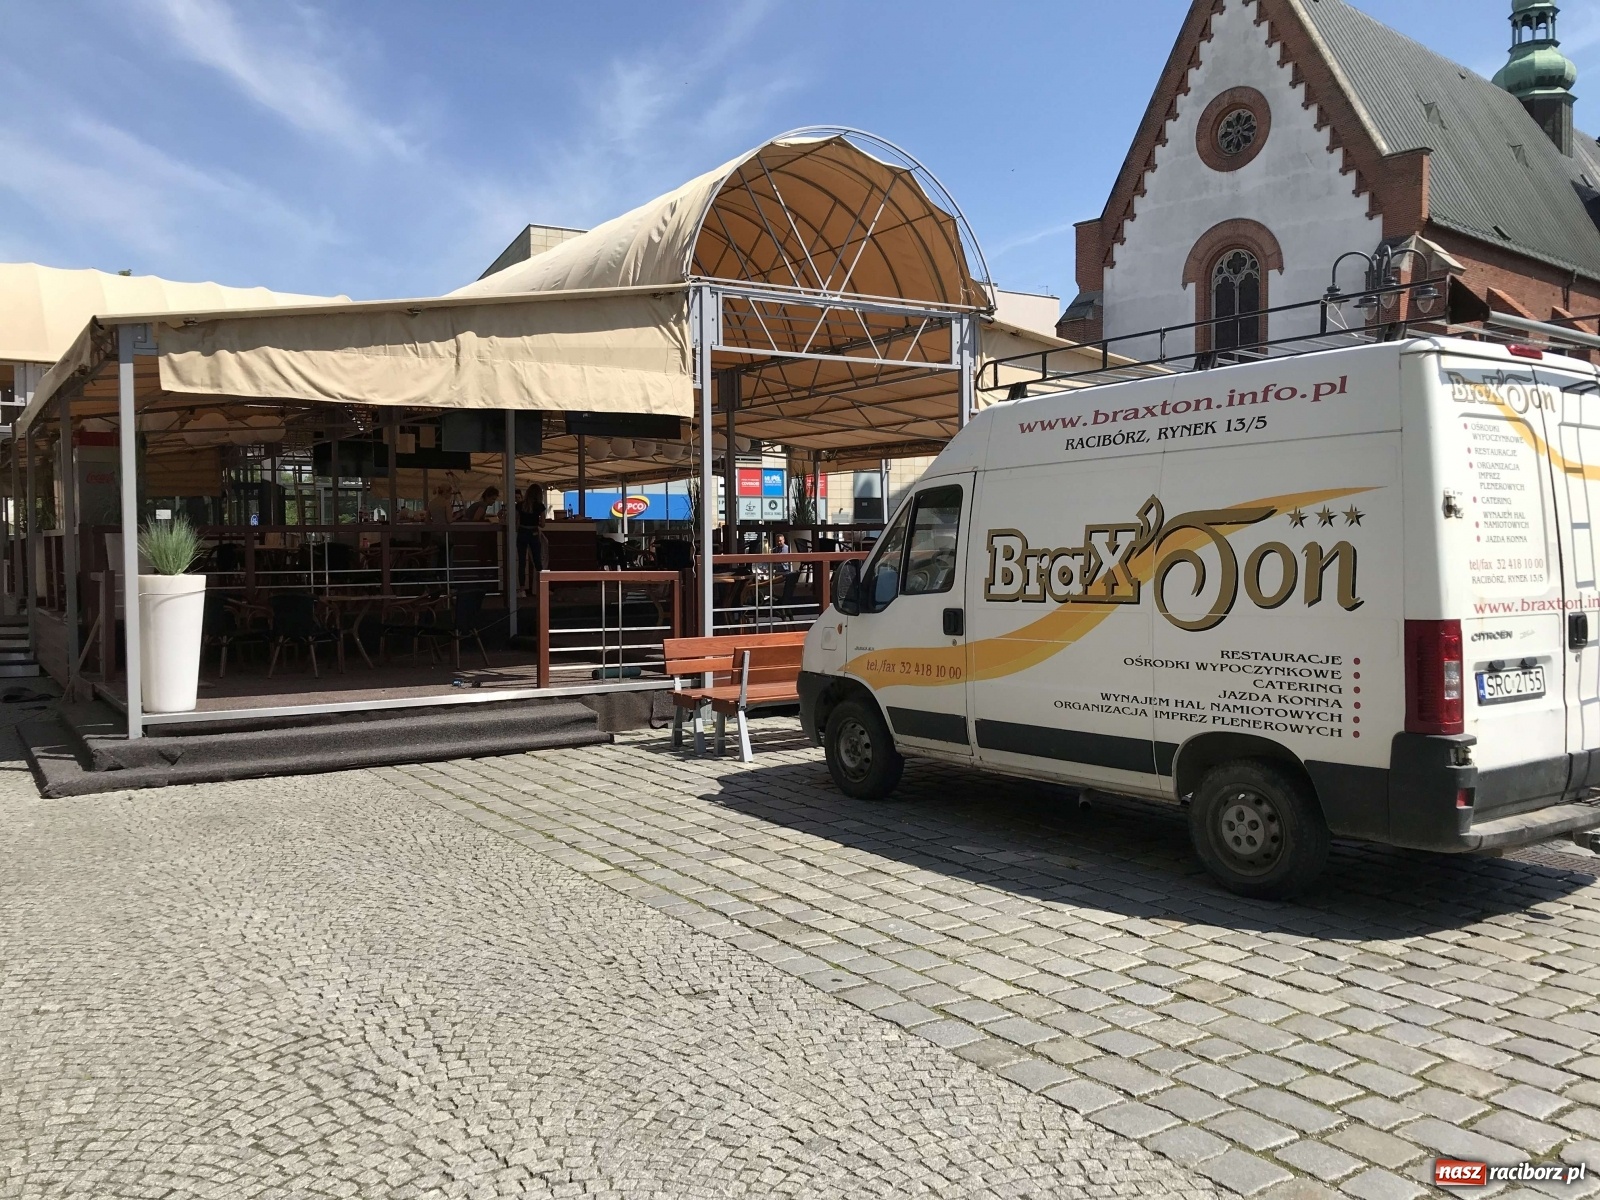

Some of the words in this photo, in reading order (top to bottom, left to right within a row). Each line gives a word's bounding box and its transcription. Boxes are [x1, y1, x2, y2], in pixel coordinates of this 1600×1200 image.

[1018, 375, 1348, 433] www.braxton.info.pl
[1471, 422, 1500, 432] OŚRODKI
[1064, 428, 1151, 450] RACIBÓRZ,
[1156, 420, 1217, 441] RYNEK
[1224, 415, 1268, 433] 13/5
[1472, 433, 1524, 443] WYPOCZYNKOWE
[1475, 447, 1517, 456] RESTAURACJE
[1477, 462, 1520, 470] ORGANIZACJA
[1478, 472, 1500, 480] IMPREZ
[1480, 482, 1525, 491] PLENEROWYCH
[1481, 496, 1512, 505] CATERING
[617, 502, 644, 510] PPCO
[1483, 511, 1513, 519] WYNAJEM
[1514, 511, 1526, 519] HAL
[1484, 521, 1529, 529] NAMIOTOWYCH
[1486, 535, 1505, 543] JAZDA
[1506, 535, 1528, 543] KONNA
[1497, 559, 1506, 570] 32
[1508, 558, 1521, 569] 418
[1524, 558, 1533, 569] 10
[1535, 558, 1544, 568] 00
[1508, 574, 1528, 583] RYNEK
[1529, 574, 1544, 583] 13/5
[1220, 650, 1342, 666] RESTAURACJE
[900, 661, 911, 674] 32
[914, 663, 932, 676] 418
[935, 665, 946, 678] 10
[949, 667, 962, 679] 00
[1123, 655, 1190, 670] OŚRODKI
[1195, 662, 1342, 680] WYPOCZYNKOWE
[1252, 678, 1343, 694] CATERING
[1486, 674, 1512, 696] SRC
[1515, 671, 1542, 693] 2T55
[1218, 689, 1272, 703] JAZDA
[1277, 694, 1342, 709] KONNA
[1100, 692, 1170, 707] WYNAJEM
[1174, 698, 1205, 710] HAL
[1210, 702, 1342, 723] NAMIOTOWYCH
[1053, 700, 1148, 717] ORGANIZACJA
[1154, 709, 1208, 724] IMPREZ
[1212, 715, 1342, 738] PLENEROWYCH
